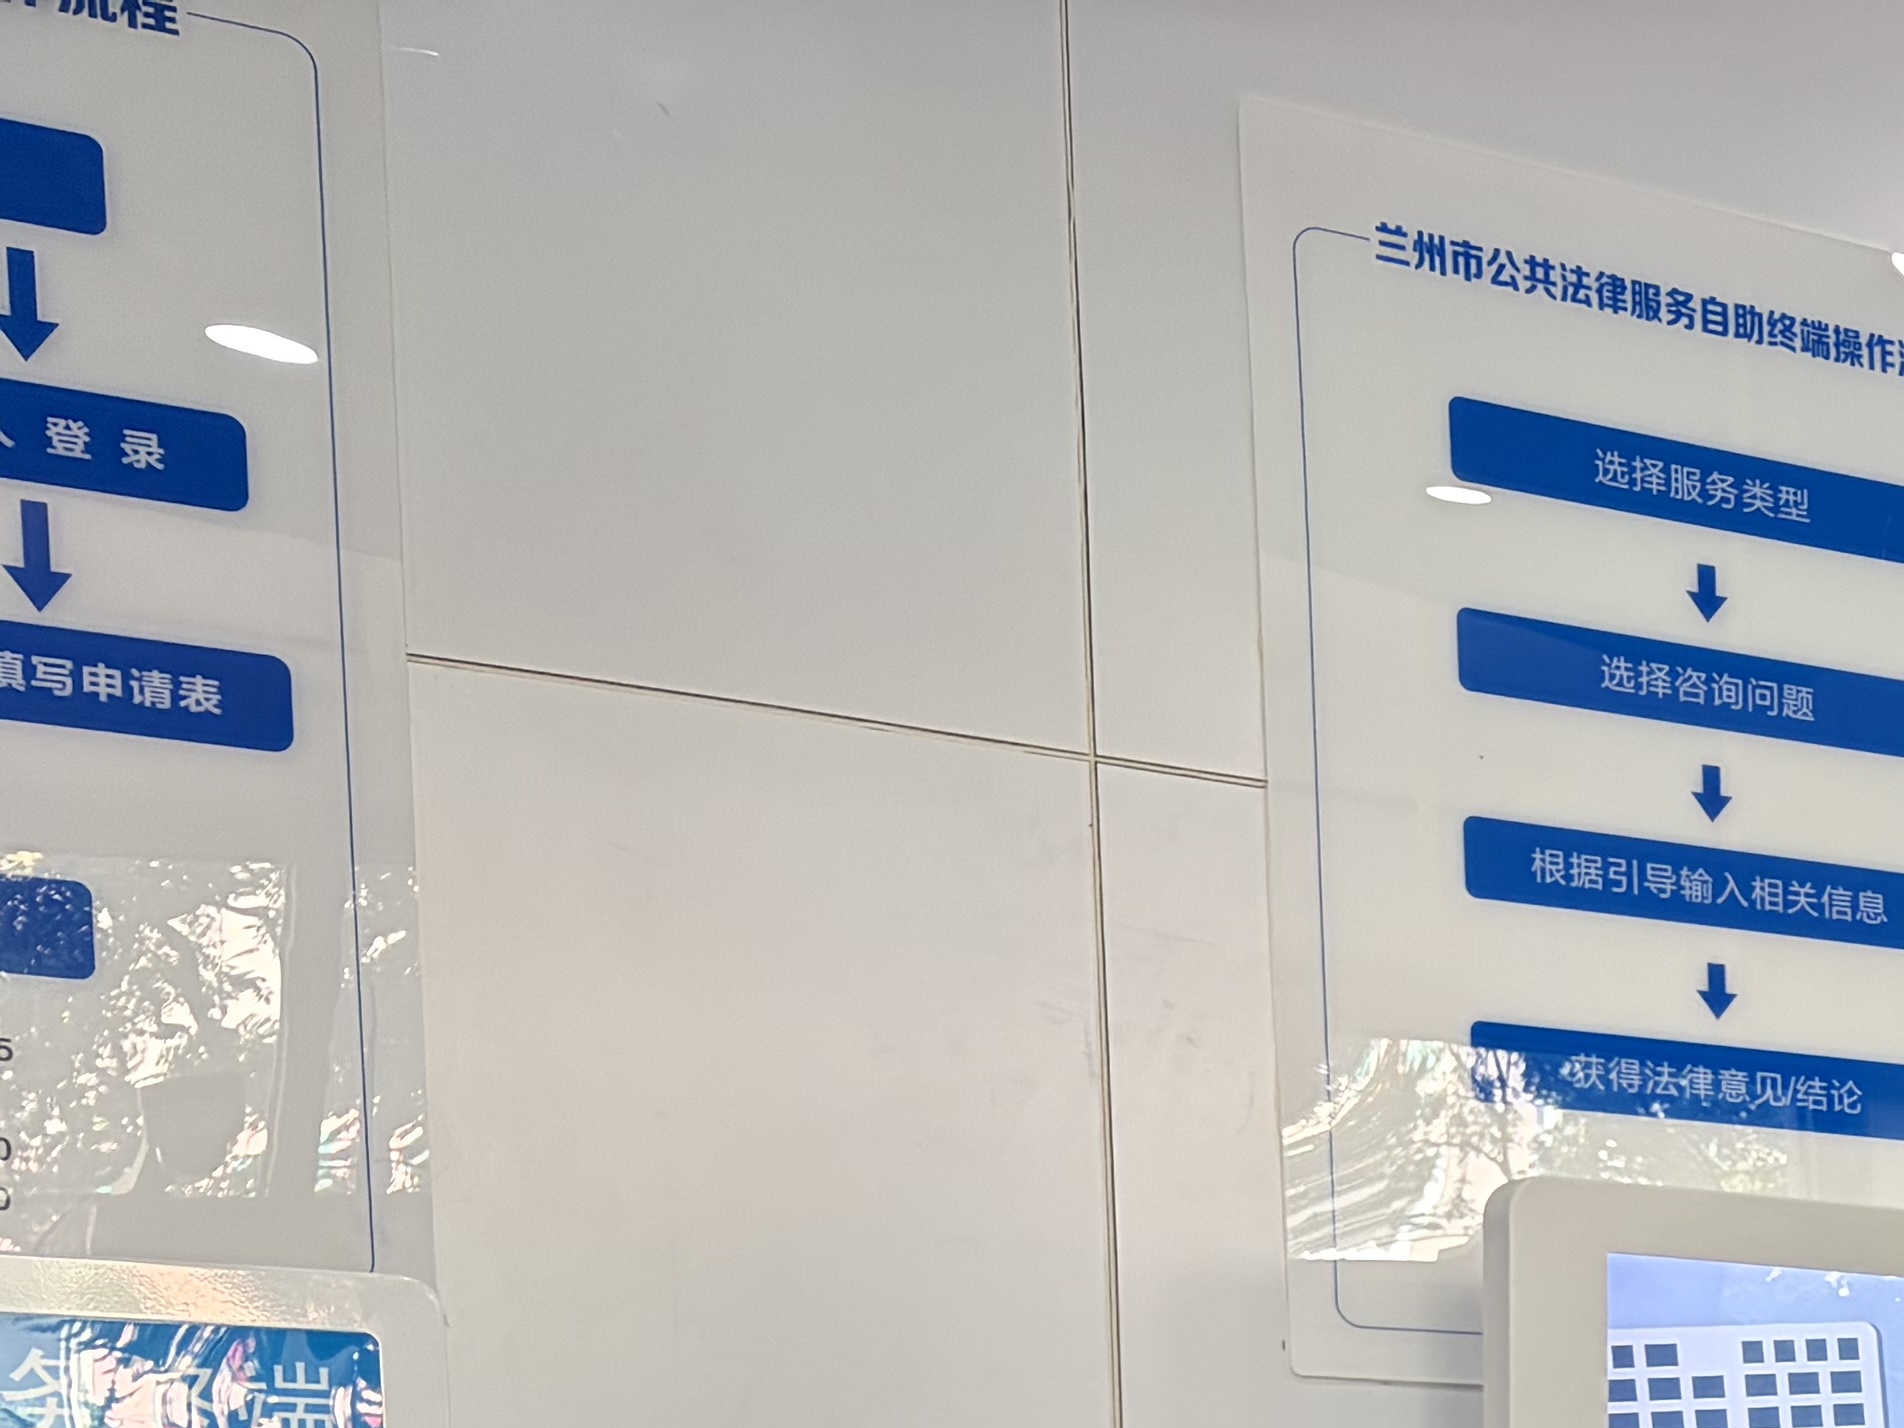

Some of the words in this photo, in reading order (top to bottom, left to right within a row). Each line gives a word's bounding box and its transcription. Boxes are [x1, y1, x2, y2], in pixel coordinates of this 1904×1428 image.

[1594, 448, 1811, 524] 选择服务类型
[1600, 654, 1815, 724] 选择咨询问题
[1530, 847, 1889, 926] 根据引导输入相关信息
[1570, 1053, 1864, 1116] 获得法律意见/结论
